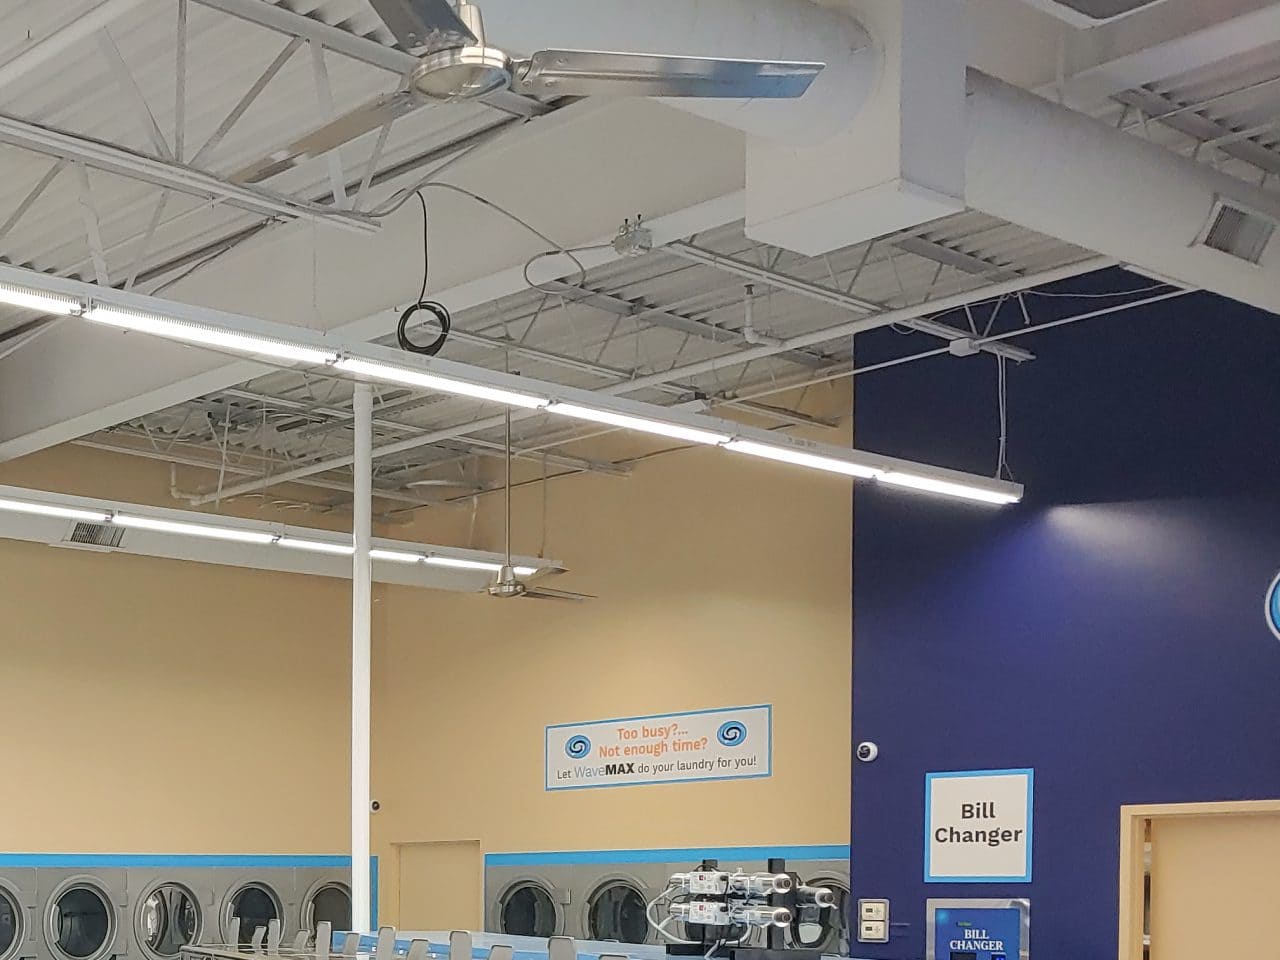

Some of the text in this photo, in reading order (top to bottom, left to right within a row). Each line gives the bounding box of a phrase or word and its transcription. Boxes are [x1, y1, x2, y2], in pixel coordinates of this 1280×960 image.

[617, 723, 689, 741] Too busy?...
[599, 737, 708, 759] Not enough time?
[557, 755, 757, 780] Let WaveMAX do your laundry for you!
[961, 801, 996, 819] Bill
[934, 827, 1023, 847] Changer
[964, 929, 990, 939] BILL
[949, 940, 1004, 951] CHANGER
